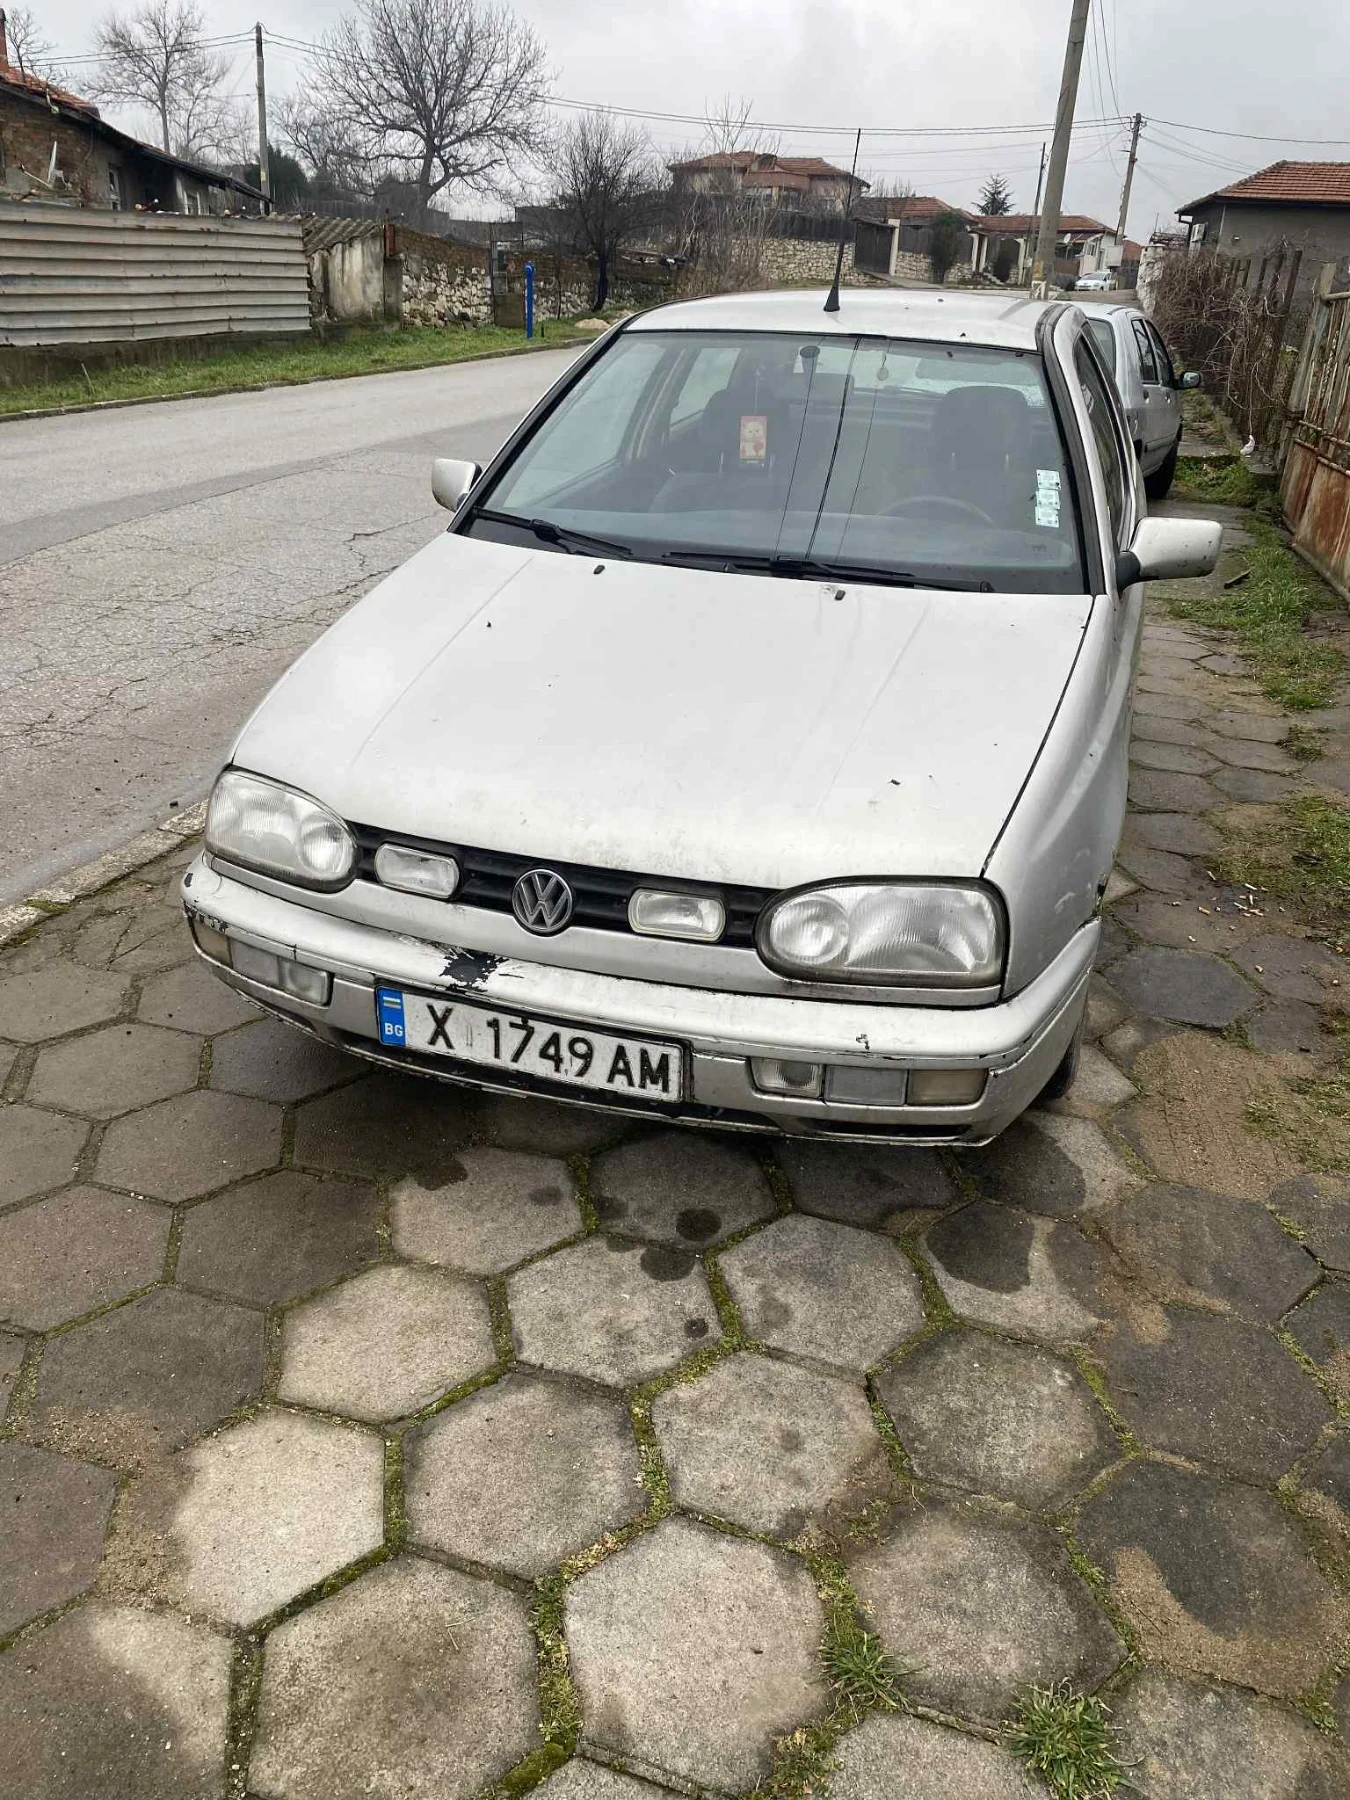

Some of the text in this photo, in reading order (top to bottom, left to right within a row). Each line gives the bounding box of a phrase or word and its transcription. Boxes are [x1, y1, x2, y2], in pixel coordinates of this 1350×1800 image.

[515, 870, 569, 930] VW
[384, 1023, 403, 1037] BG
[426, 1003, 671, 1094] X 1749 AM
